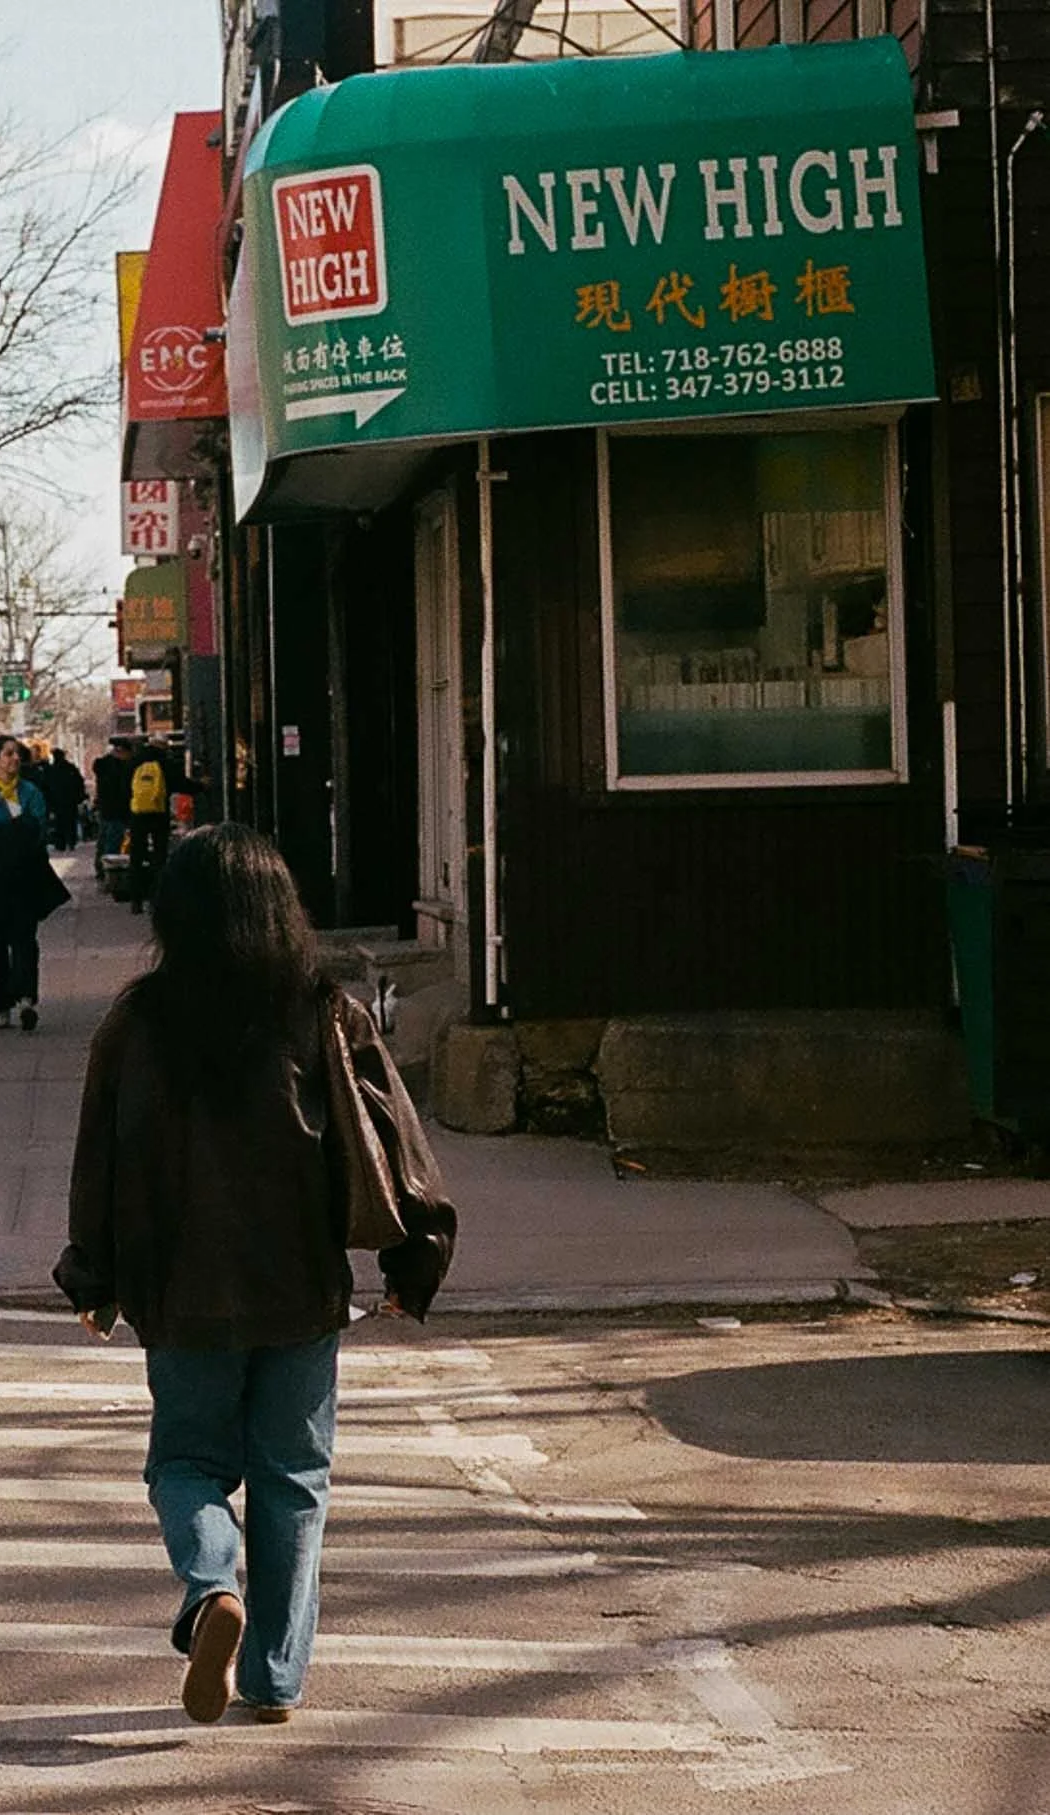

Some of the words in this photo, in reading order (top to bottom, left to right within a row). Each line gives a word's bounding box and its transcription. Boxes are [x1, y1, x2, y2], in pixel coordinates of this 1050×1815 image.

[286, 184, 360, 241] NEW
[502, 163, 676, 255] NEW
[699, 145, 902, 240] HIGH
[289, 250, 370, 306] HIGH
[139, 344, 208, 372] EMC
[601, 352, 654, 376] TEL:
[662, 337, 843, 372] 718-762-6888
[353, 371, 372, 385] THE
[375, 369, 407, 383] BACK
[590, 380, 657, 405] CELL:
[665, 366, 845, 400] 347-379-3112
